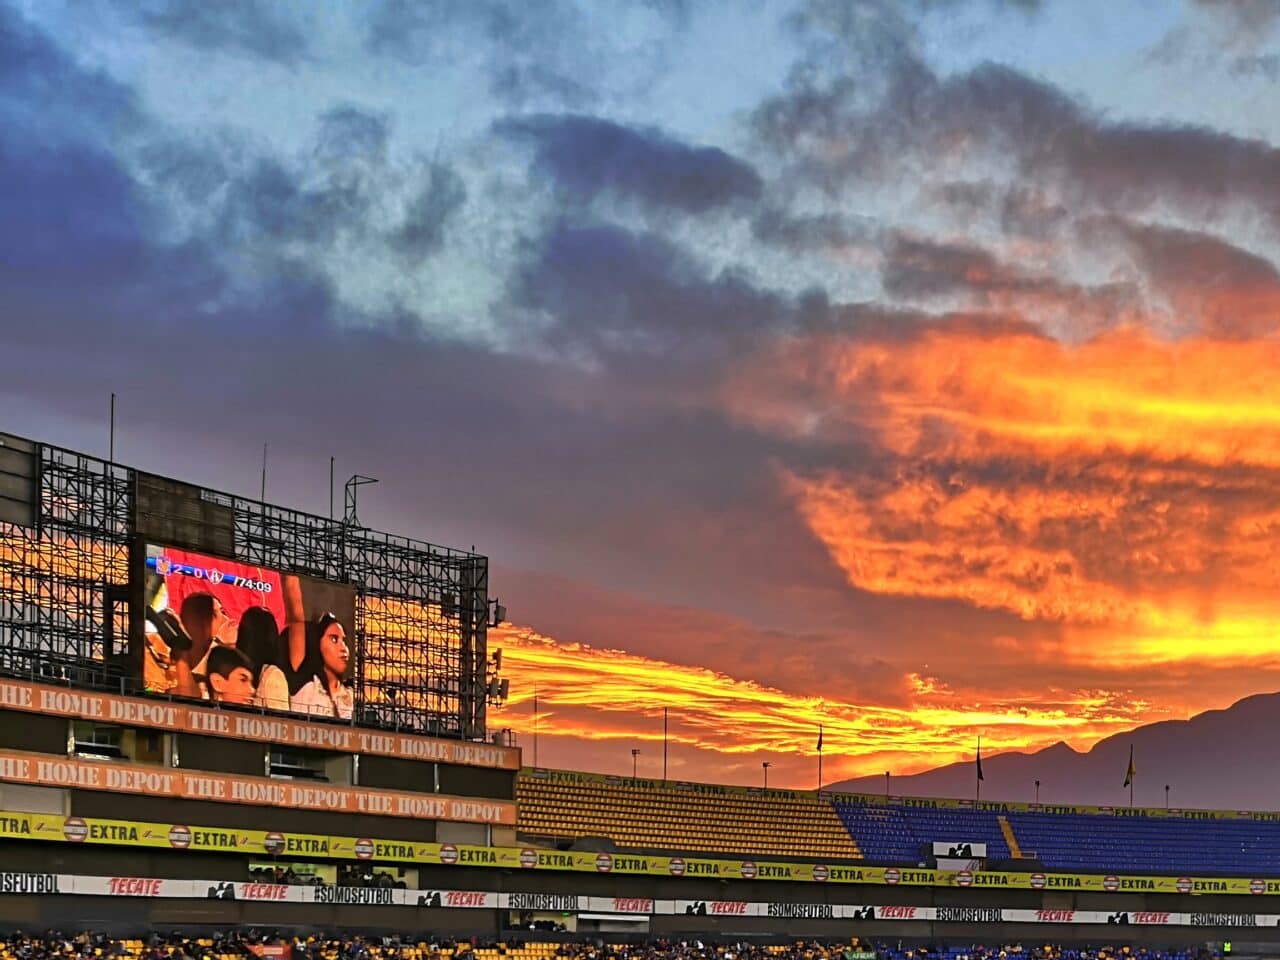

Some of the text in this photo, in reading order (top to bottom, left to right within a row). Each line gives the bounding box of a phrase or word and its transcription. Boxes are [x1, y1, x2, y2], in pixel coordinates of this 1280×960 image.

[40, 690, 103, 717] HOME
[110, 698, 177, 726] DEPOT
[187, 711, 352, 749] THE HOME DEPOT
[358, 734, 507, 765] THE HOME DEPOT
[38, 761, 97, 786] HOME
[106, 769, 174, 794] DEPOT
[184, 776, 351, 810] THE HOME DEPOT
[356, 794, 503, 823] THE HOME DEPOT
[90, 826, 138, 841] EXTRA
[193, 833, 238, 847] EXTRA
[287, 837, 328, 853] EXTRA
[376, 845, 415, 858] EXTRA
[460, 851, 496, 863] EXTRA
[539, 855, 574, 866] EXTRA
[614, 859, 648, 870] EXTRA
[687, 862, 720, 874] EXTRA
[759, 866, 791, 877] EXTRA
[830, 869, 864, 880] EXTRA
[902, 872, 935, 883] EXTRA
[109, 877, 163, 895] TECATE
[975, 874, 1008, 885] EXTRA
[1048, 876, 1081, 887] EXTRA
[1121, 878, 1154, 889] EXTRA
[239, 883, 289, 899] TECATE
[1194, 882, 1227, 892] EXTRA
[314, 885, 395, 904] #SOMOSFUTBOL
[445, 892, 487, 905] TECATE
[508, 894, 580, 910] #SOMOSFUTBOL
[613, 898, 652, 911] TECATE
[710, 902, 748, 914] TECATE
[767, 904, 835, 918] #SOMOSFUTBOL
[878, 907, 917, 919] TECATE
[936, 908, 1003, 922] #SOMOSFUTBOL
[1036, 910, 1075, 922] TECATE
[1133, 913, 1170, 923] TECATE
[1191, 913, 1257, 926] #SOMOSFUTBOL
